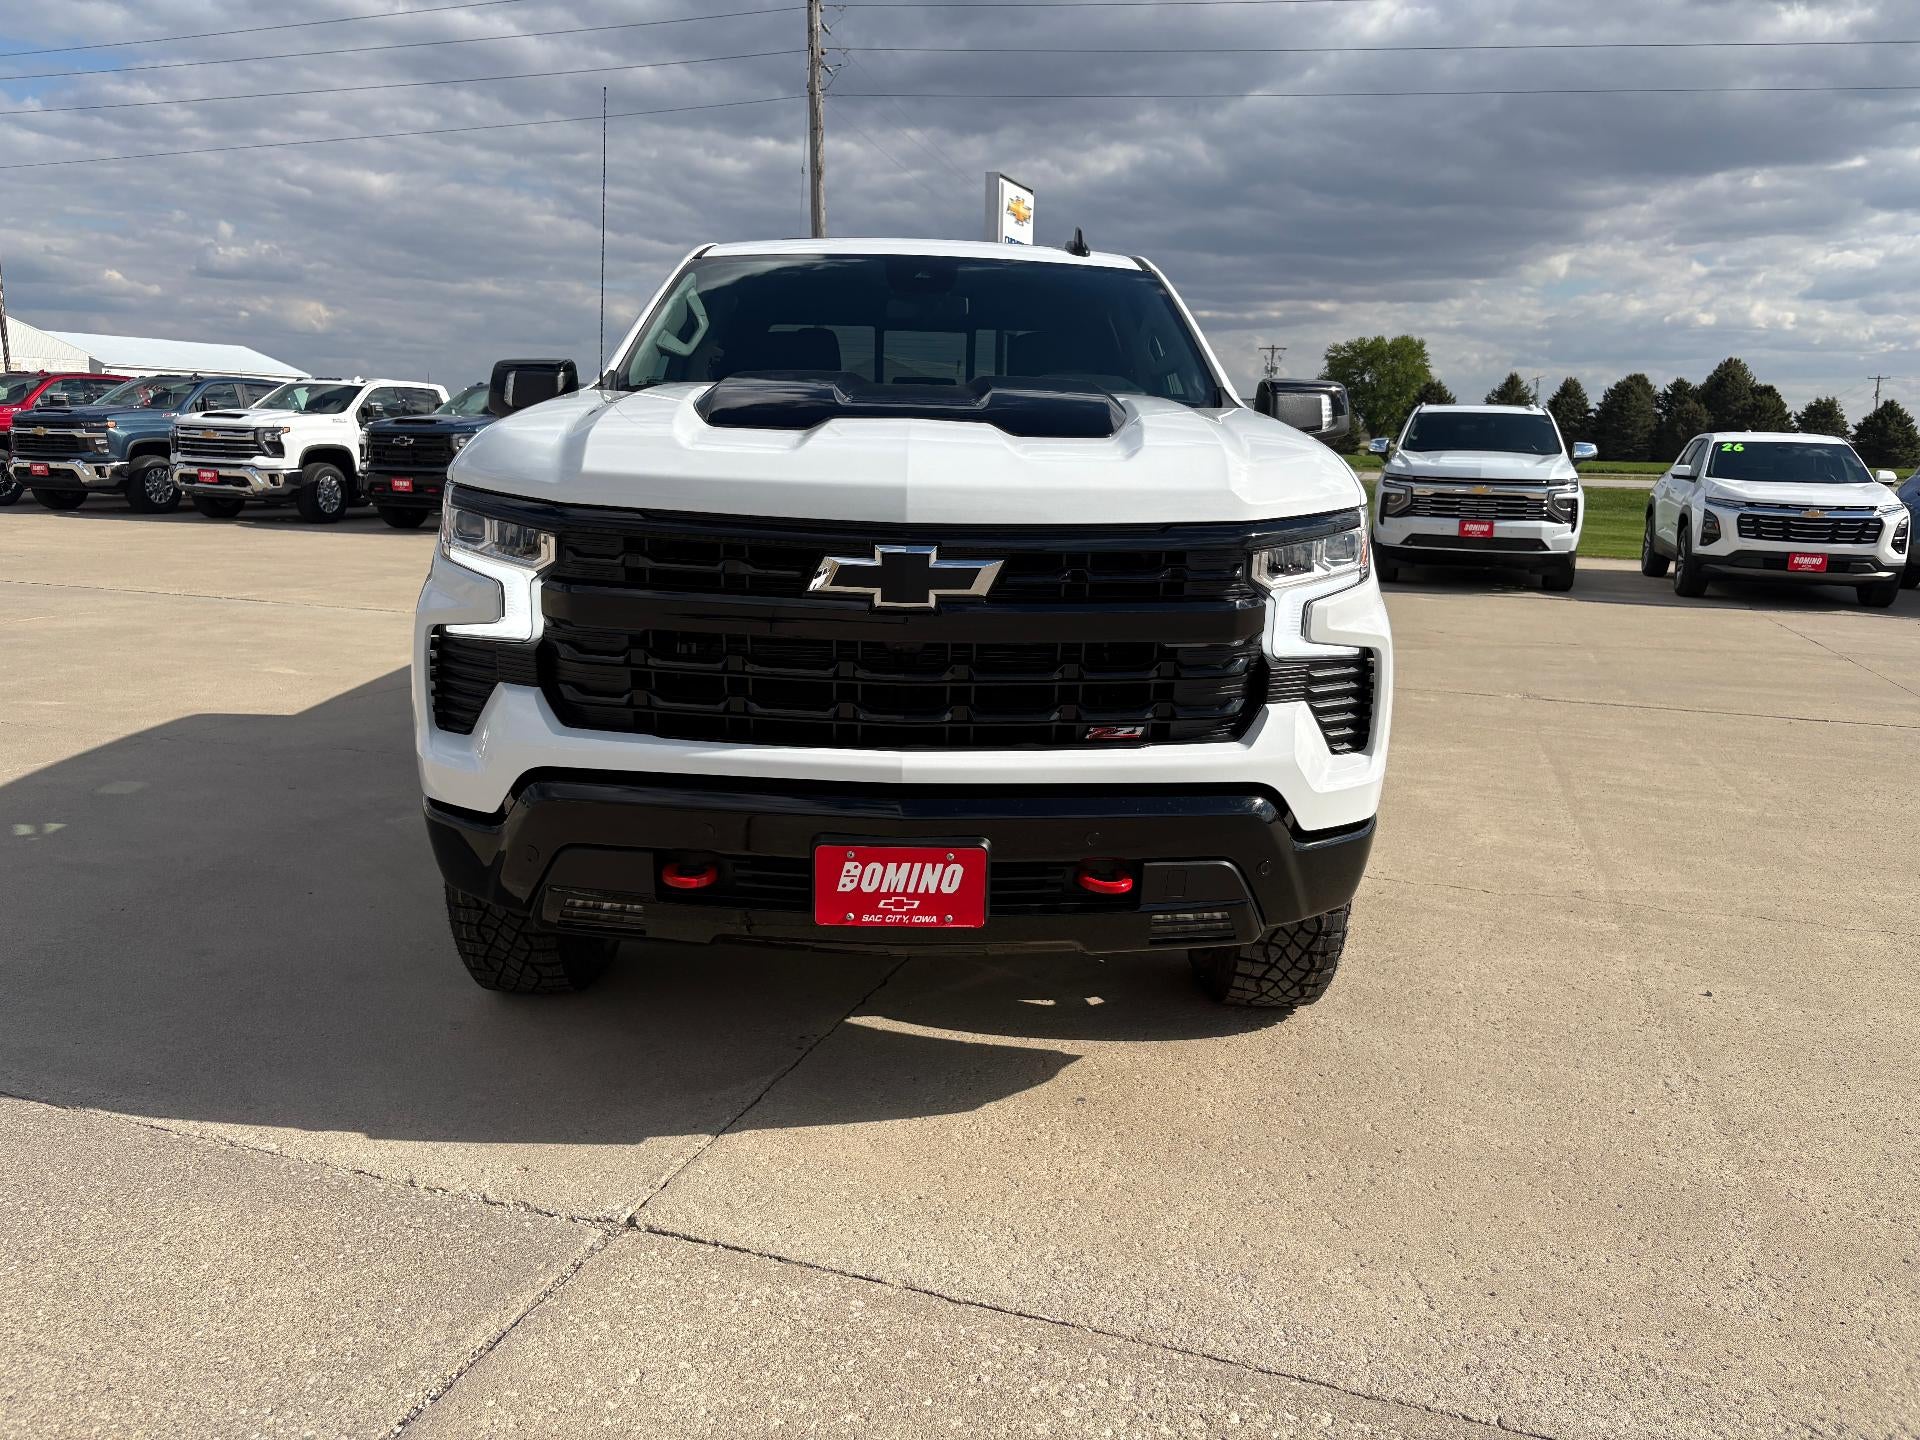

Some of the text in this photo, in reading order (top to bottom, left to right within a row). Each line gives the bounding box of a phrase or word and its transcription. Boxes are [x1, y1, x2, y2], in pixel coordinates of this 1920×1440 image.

[1721, 442, 1745, 452] 26
[1793, 556, 1823, 565] DOMINO
[836, 861, 964, 894] DOMINO
[861, 914, 937, 925] SAC CITY, IOWA
